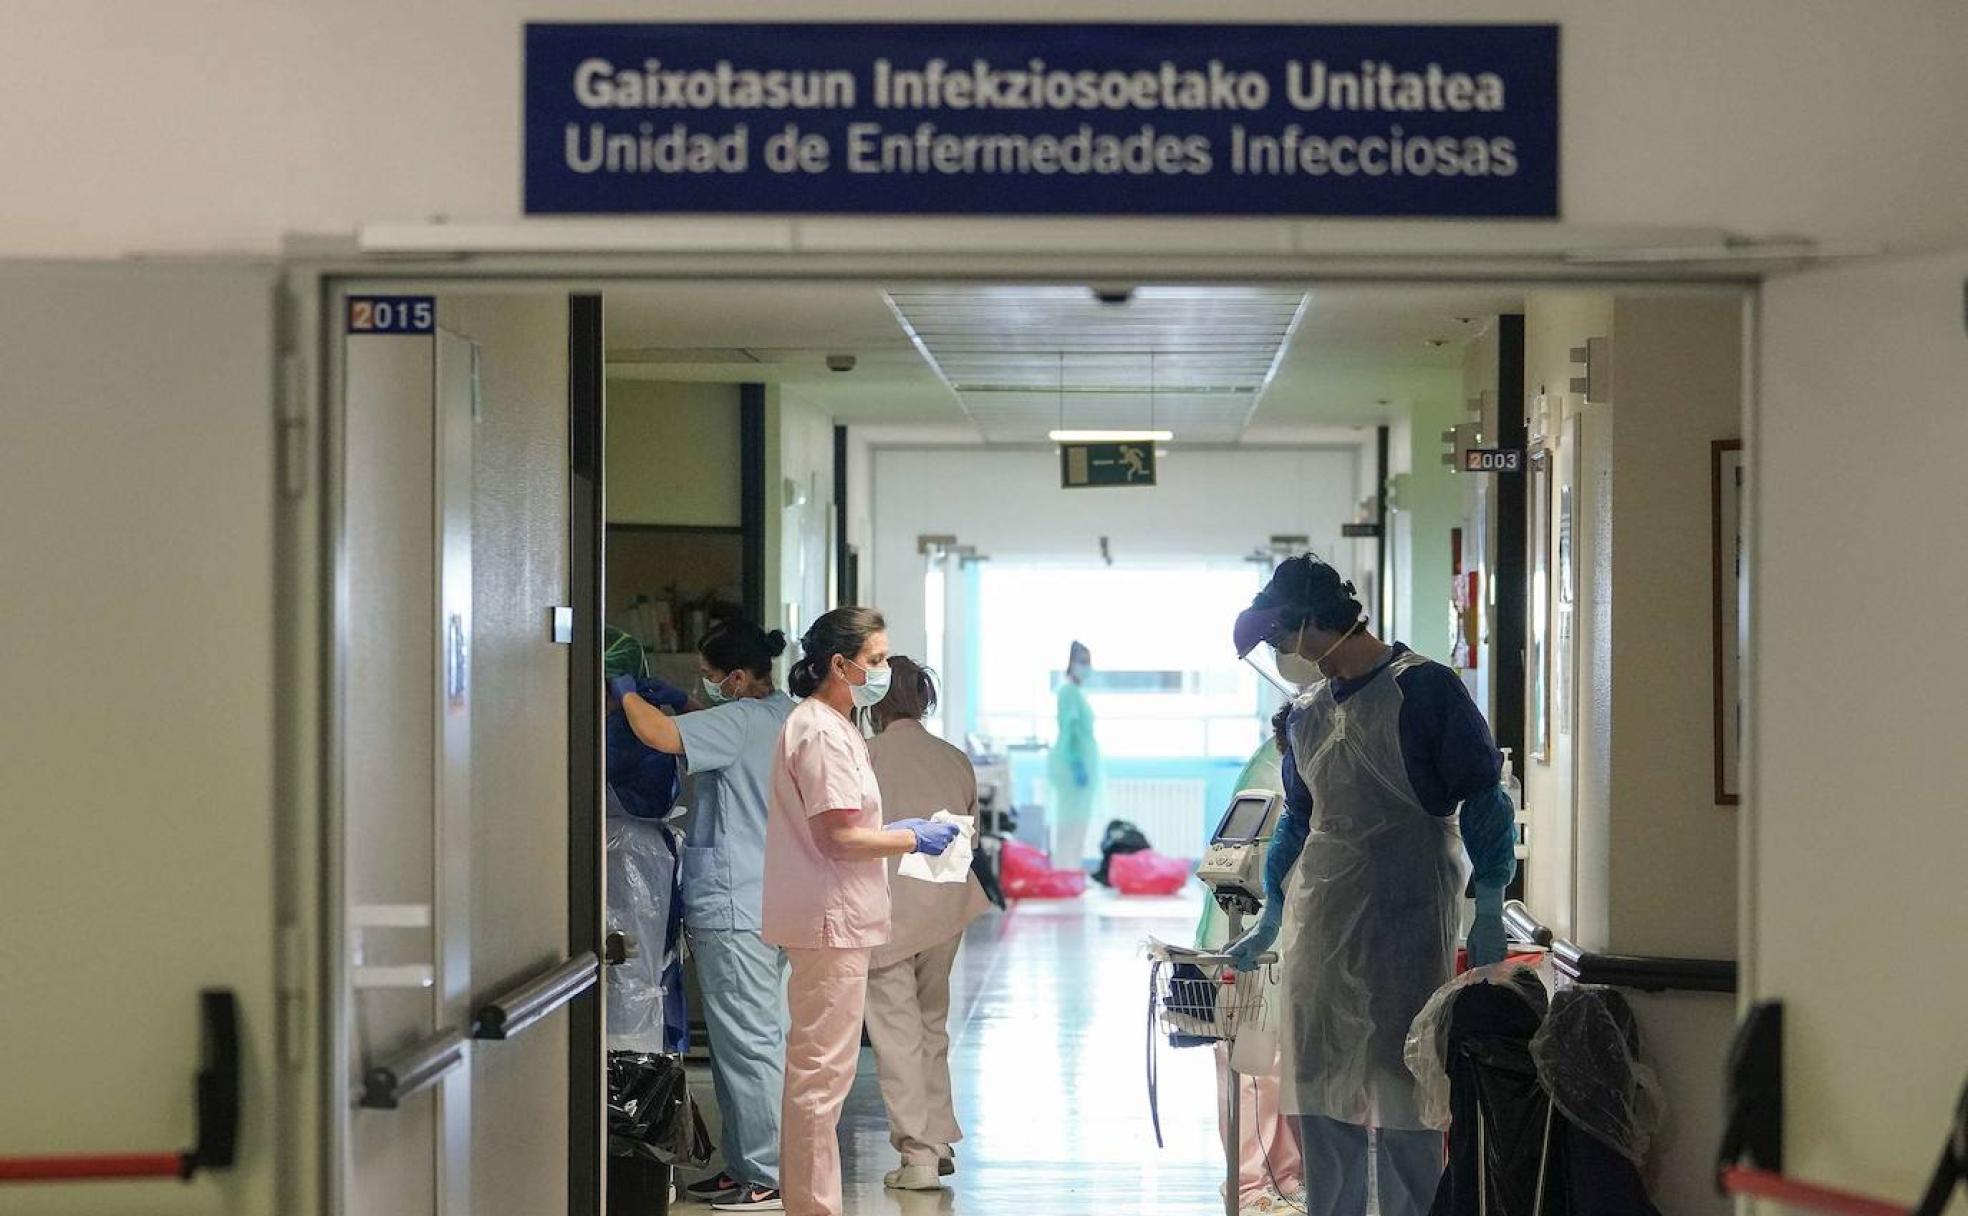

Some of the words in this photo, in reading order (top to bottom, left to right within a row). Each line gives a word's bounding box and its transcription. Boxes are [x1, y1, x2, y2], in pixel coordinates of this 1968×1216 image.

[574, 59, 856, 109] Gaixotasun
[875, 59, 1268, 110] Infekziosoetako
[1288, 60, 1504, 111] Unitatea
[565, 122, 747, 173] Unidad
[765, 123, 828, 173] de
[848, 123, 1211, 174] Enfermedades
[1232, 125, 1518, 175] Infecciosas
[352, 302, 432, 329] 2015
[1470, 453, 1517, 469] 2003
